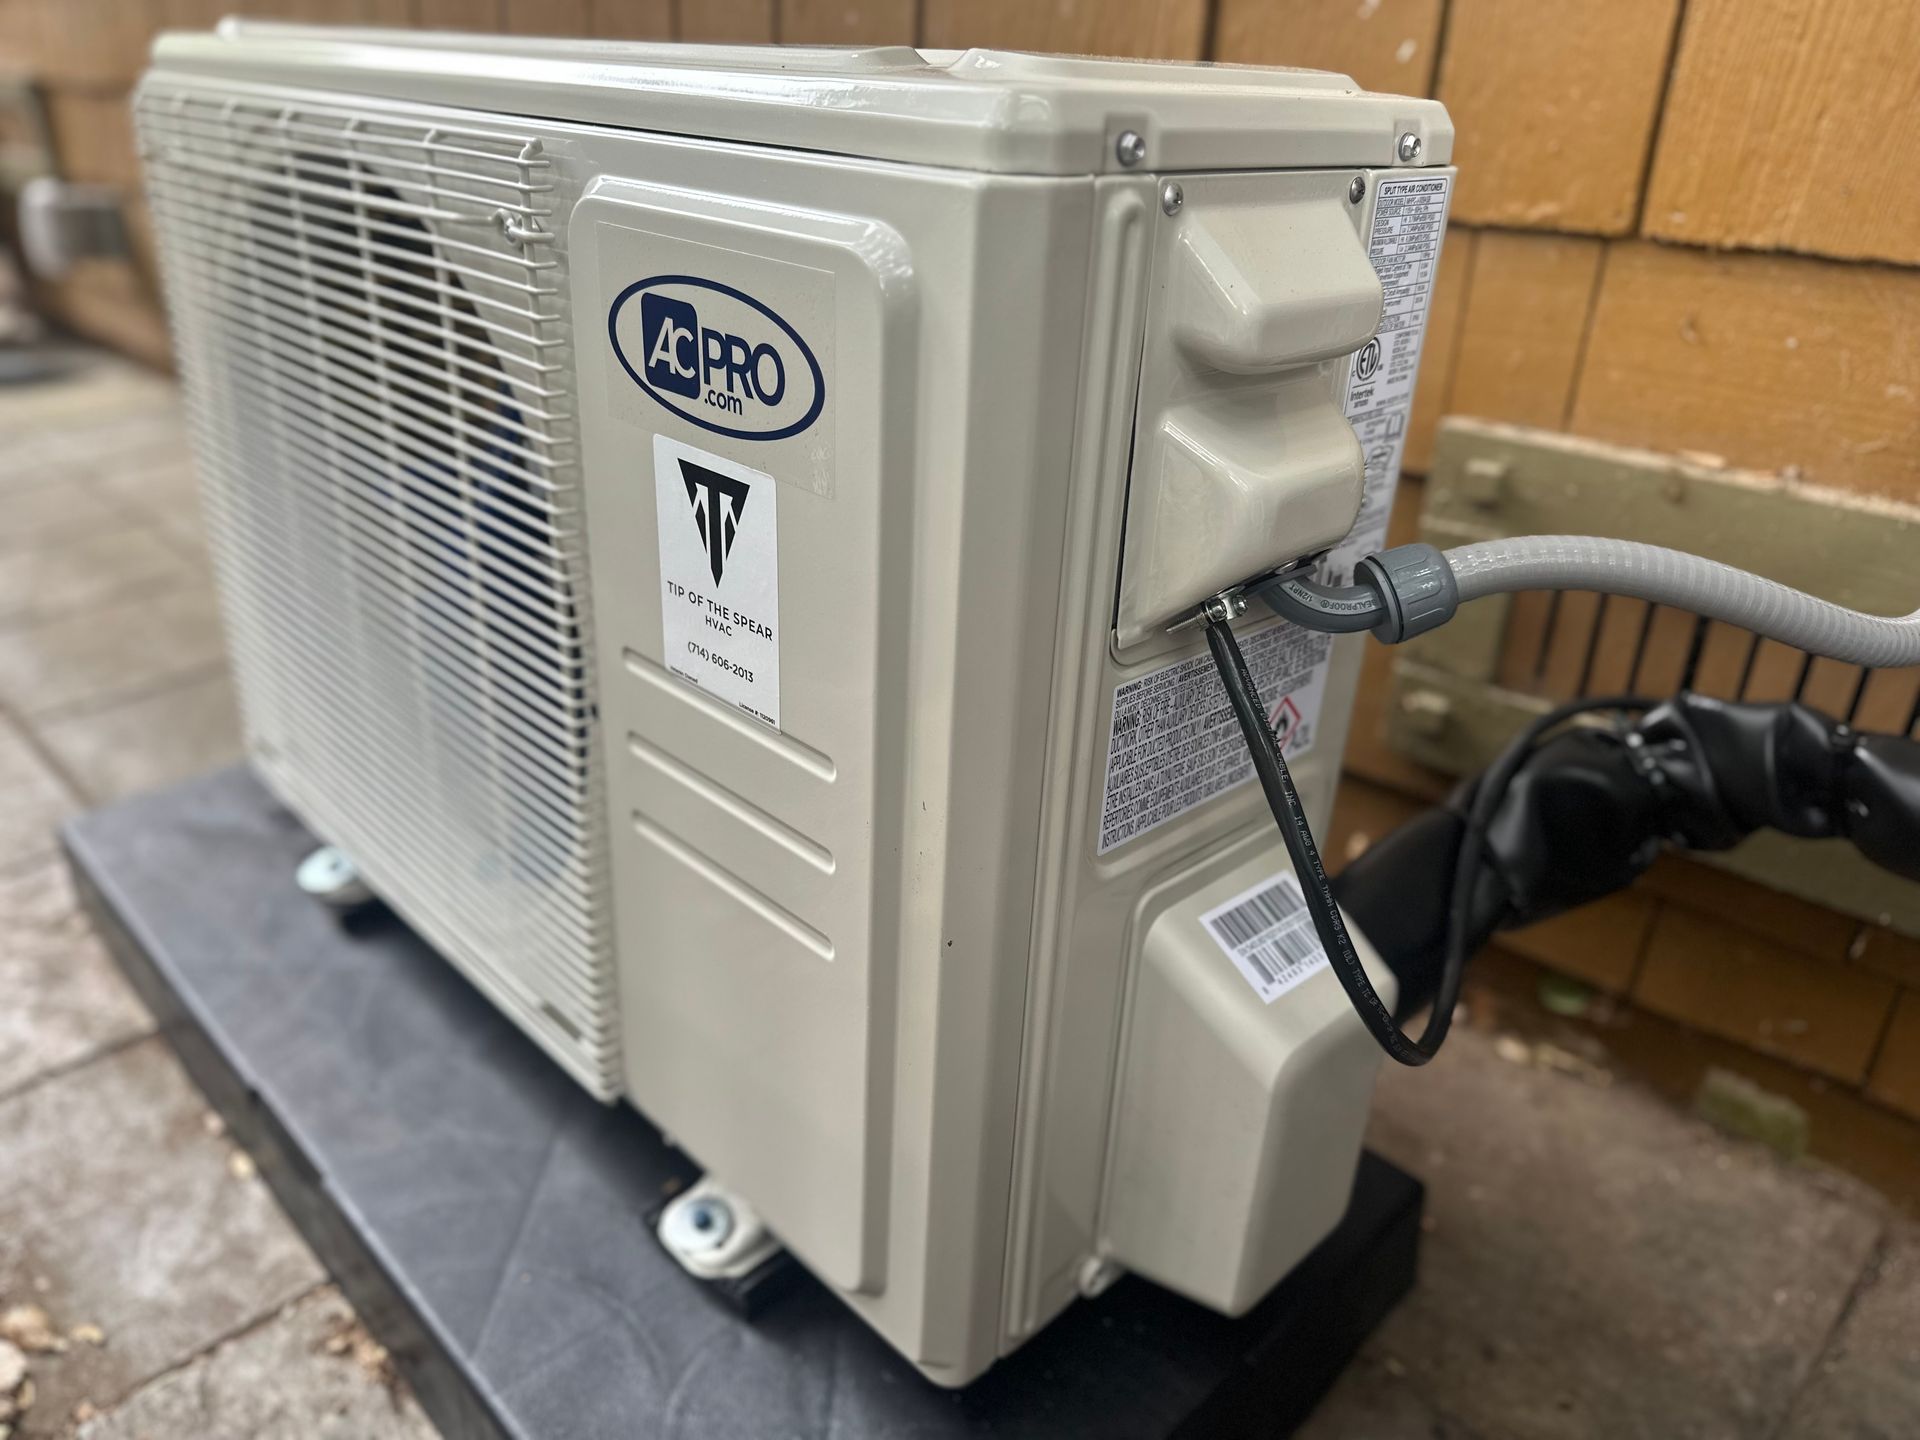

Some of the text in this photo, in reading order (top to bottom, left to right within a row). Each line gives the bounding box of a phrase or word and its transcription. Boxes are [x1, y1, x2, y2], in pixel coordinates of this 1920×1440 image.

[1384, 186, 1396, 195] SPLIT
[1396, 185, 1408, 194] TYPE
[1416, 182, 1443, 192] CONDITIONER
[704, 389, 743, 416] .com
[1289, 584, 1312, 602] 1/2NPT
[667, 580, 773, 642] TIP OF THE SPEAR
[706, 615, 732, 637] HVAC
[688, 642, 710, 662] (714)
[712, 654, 754, 683] 606-2013
